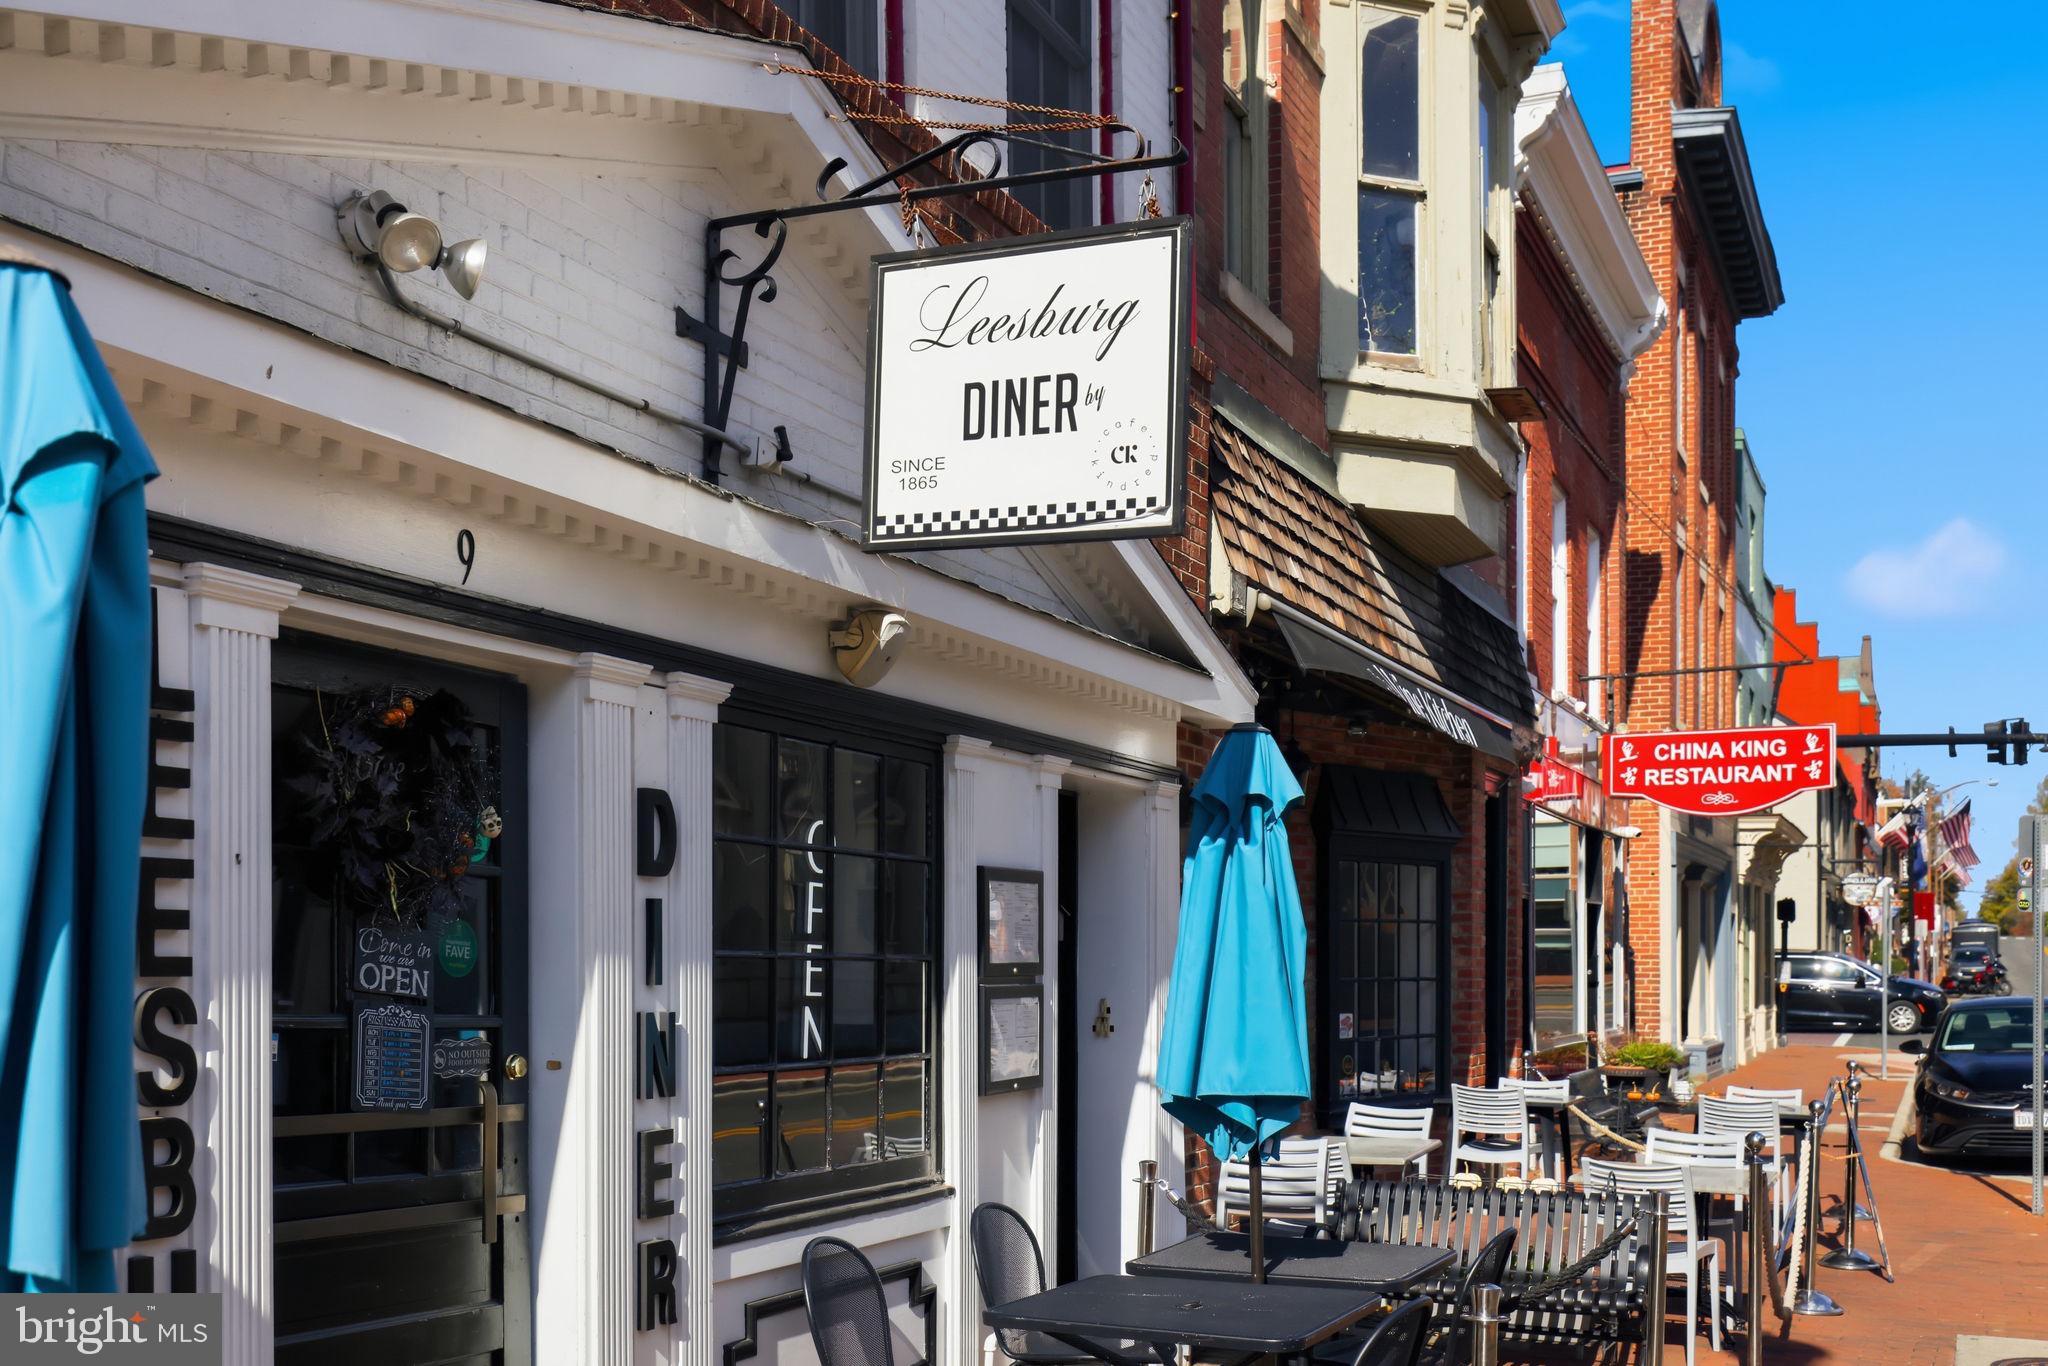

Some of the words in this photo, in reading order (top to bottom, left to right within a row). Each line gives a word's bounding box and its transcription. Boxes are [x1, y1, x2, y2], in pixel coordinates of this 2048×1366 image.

[909, 275, 1141, 362] Leesburg
[962, 372, 1079, 441] DINER
[1084, 383, 1105, 412] by
[891, 456, 946, 475] SINCE
[1110, 444, 1138, 465] CK
[899, 475, 938, 491] 1865
[457, 529, 475, 586] 9
[1654, 741, 1724, 762] CHINA
[1730, 738, 1788, 759] KING
[1644, 763, 1797, 786] RESTAURANT
[359, 927, 413, 957] Come
[417, 942, 432, 959] in
[445, 945, 471, 959] FAVE
[378, 954, 395, 964] we
[397, 957, 415, 967] are
[359, 962, 430, 997] OPEN
[448, 1049, 460, 1058] NO
[461, 1049, 491, 1058] OUTSIDE
[636, 787, 678, 1331] DINER
